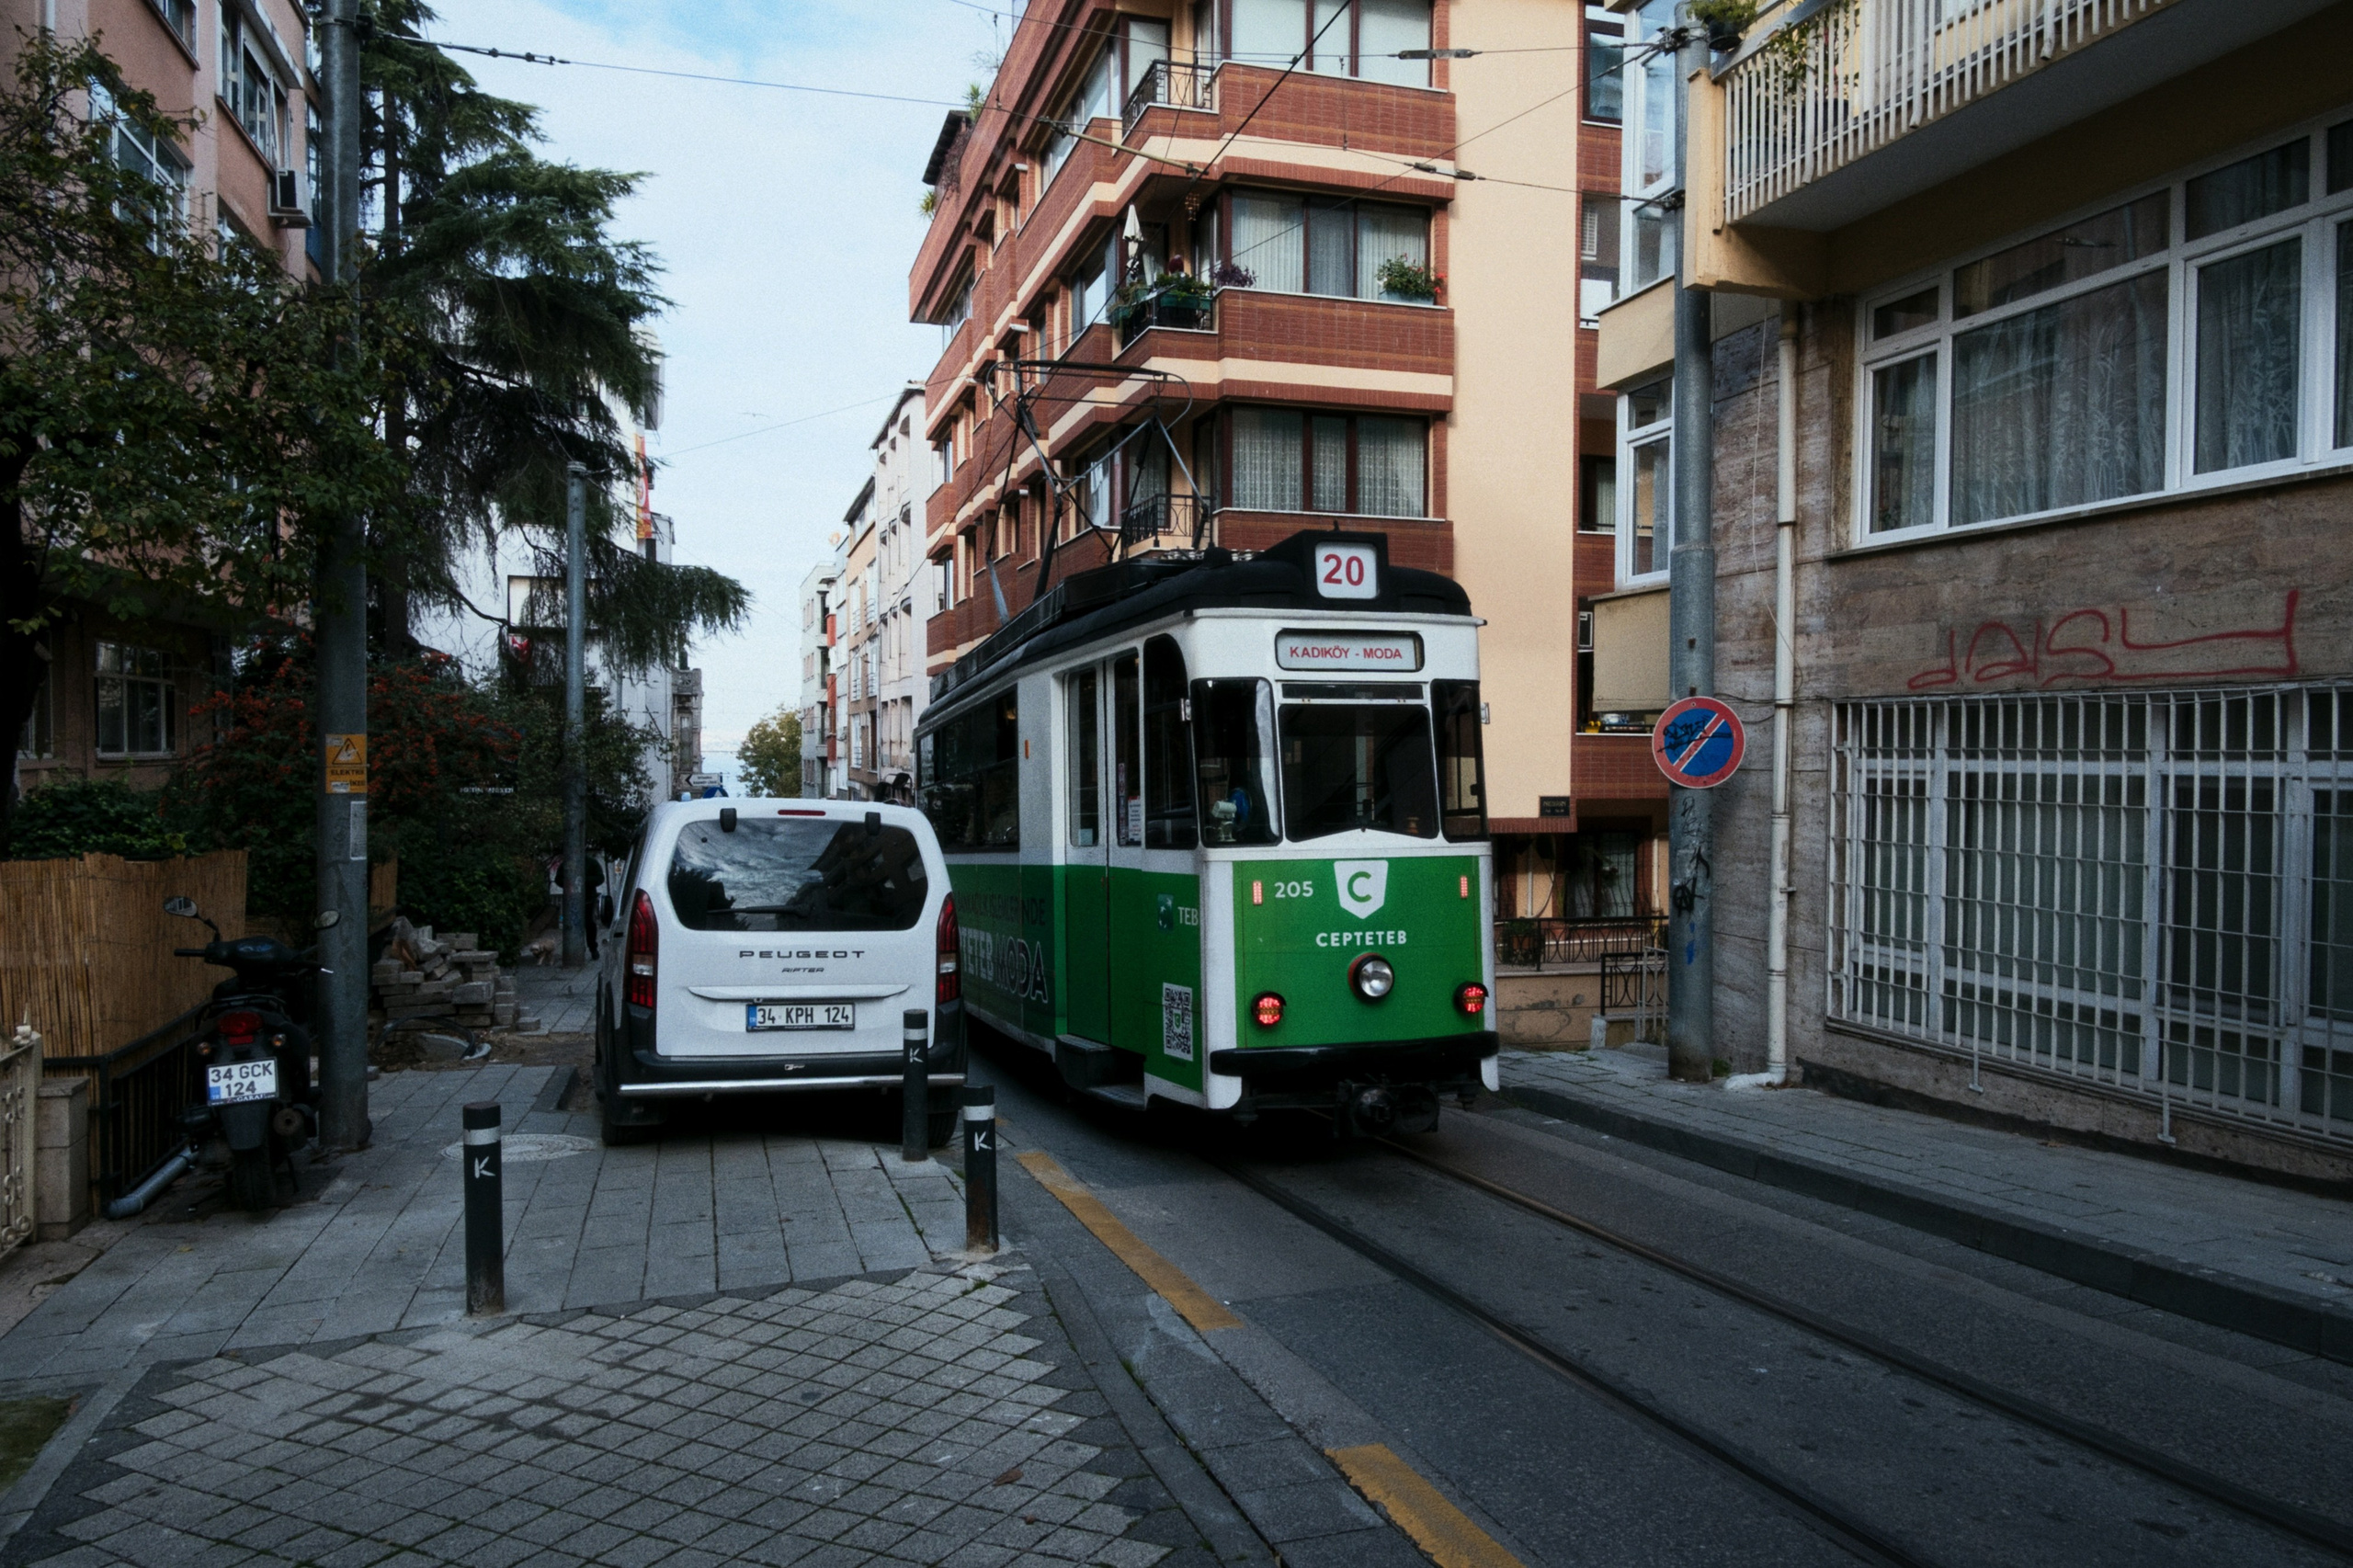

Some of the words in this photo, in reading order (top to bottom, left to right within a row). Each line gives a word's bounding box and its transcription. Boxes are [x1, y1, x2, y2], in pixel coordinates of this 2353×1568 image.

[1323, 553, 1365, 586] 20
[1290, 644, 1350, 660] KADIKÖY
[1362, 647, 1403, 660] MODA
[1274, 881, 1313, 899] 205
[1347, 870, 1372, 903] C
[1177, 906, 1199, 926] TEB
[1315, 930, 1407, 948] CEPTETEB
[739, 950, 866, 959] PEUGEOT
[960, 926, 994, 983] TETEB
[995, 933, 1049, 1005] MODA
[757, 1007, 776, 1025] 34
[785, 1006, 814, 1024] KPH
[824, 1006, 849, 1023] 124
[909, 1047, 925, 1064] K
[210, 1067, 233, 1083] 34
[239, 1062, 273, 1079] GCK
[225, 1081, 256, 1096] 124
[973, 1131, 993, 1152] K
[473, 1155, 496, 1178] K
